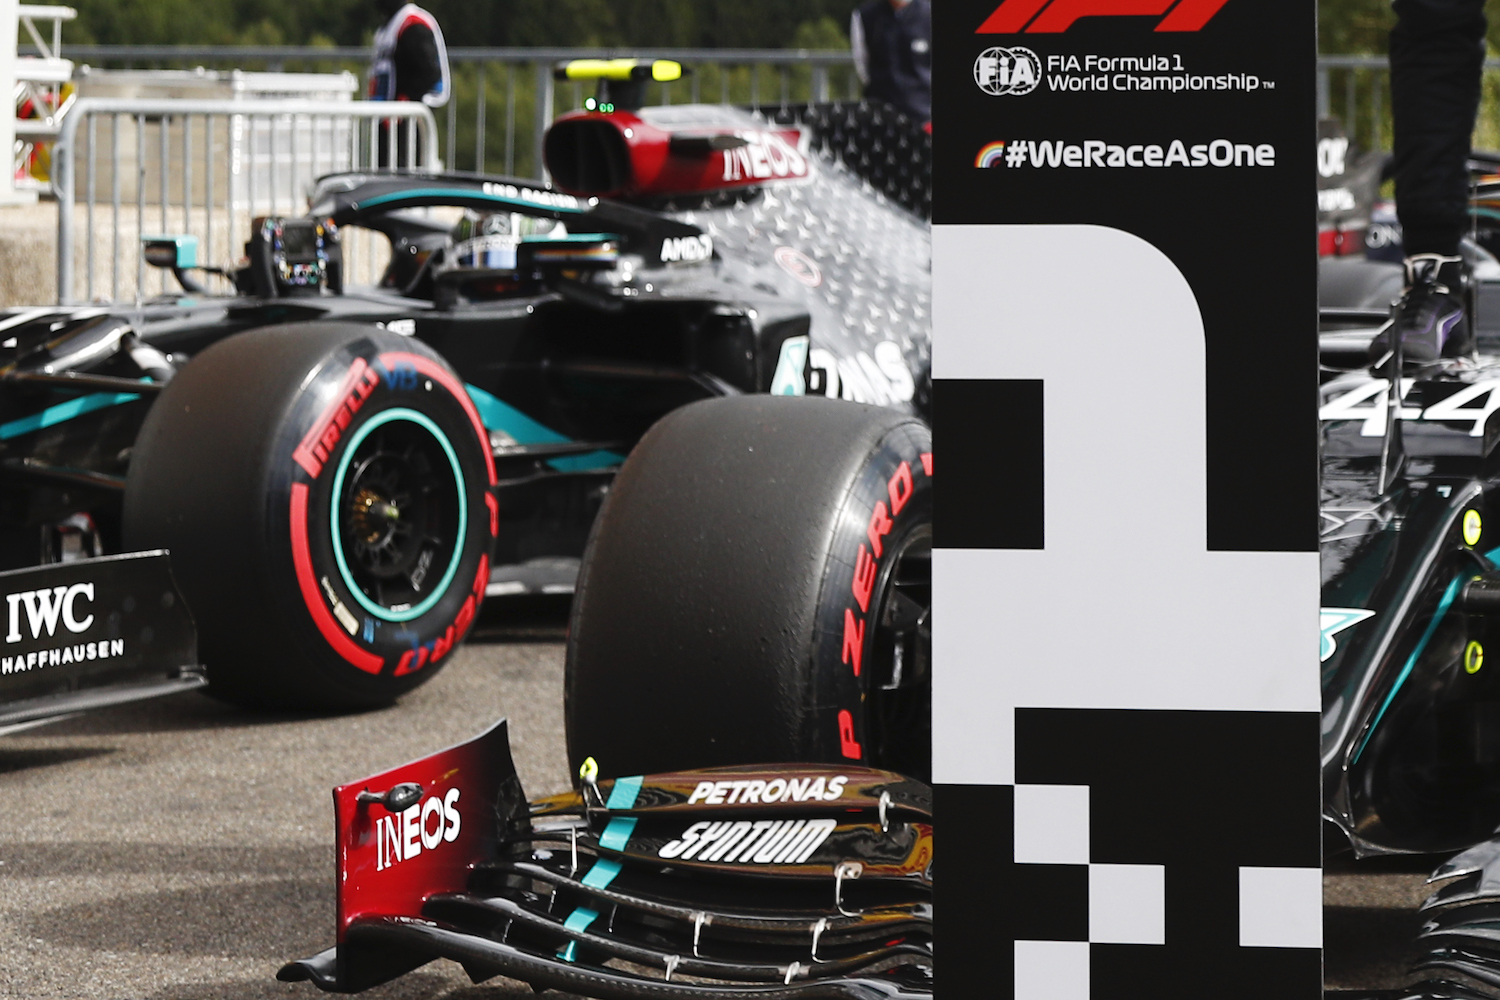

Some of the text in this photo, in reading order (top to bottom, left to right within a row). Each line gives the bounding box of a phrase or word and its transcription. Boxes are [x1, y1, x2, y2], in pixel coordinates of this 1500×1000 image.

[1047, 54, 1184, 72] FIA Formula 1
[1047, 74, 1109, 91] World
[723, 131, 807, 181] INEOS
[1005, 139, 1276, 168] #WeRaceAsOne
[292, 356, 381, 479] PIRELLI
[6, 582, 95, 643] IWC
[838, 460, 914, 760] P ZERO
[0, 638, 124, 675] HAFFHAUSEN
[687, 775, 849, 805] PETRONAS
[376, 787, 461, 872] INEOS
[658, 819, 838, 864] SYNTIUM
